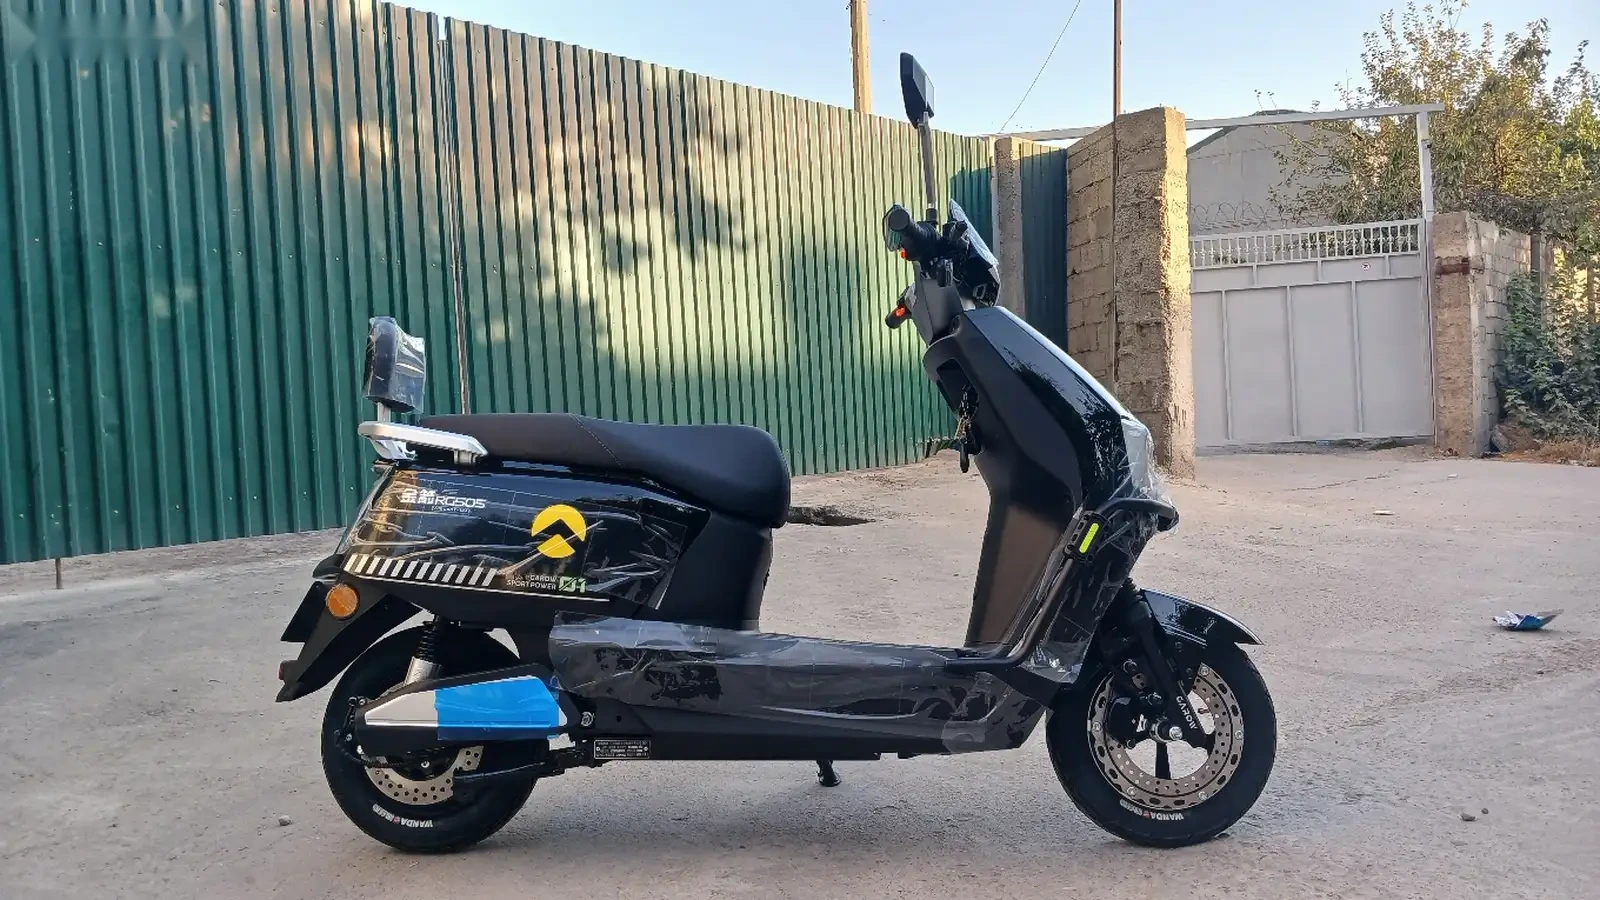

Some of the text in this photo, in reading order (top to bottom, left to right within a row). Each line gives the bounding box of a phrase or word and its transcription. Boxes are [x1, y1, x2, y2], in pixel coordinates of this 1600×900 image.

[435, 495, 487, 509] RG505
[506, 579, 557, 590] SPORT POWER
[1150, 812, 1185, 821] WANDA
[401, 817, 434, 828] WANDA
